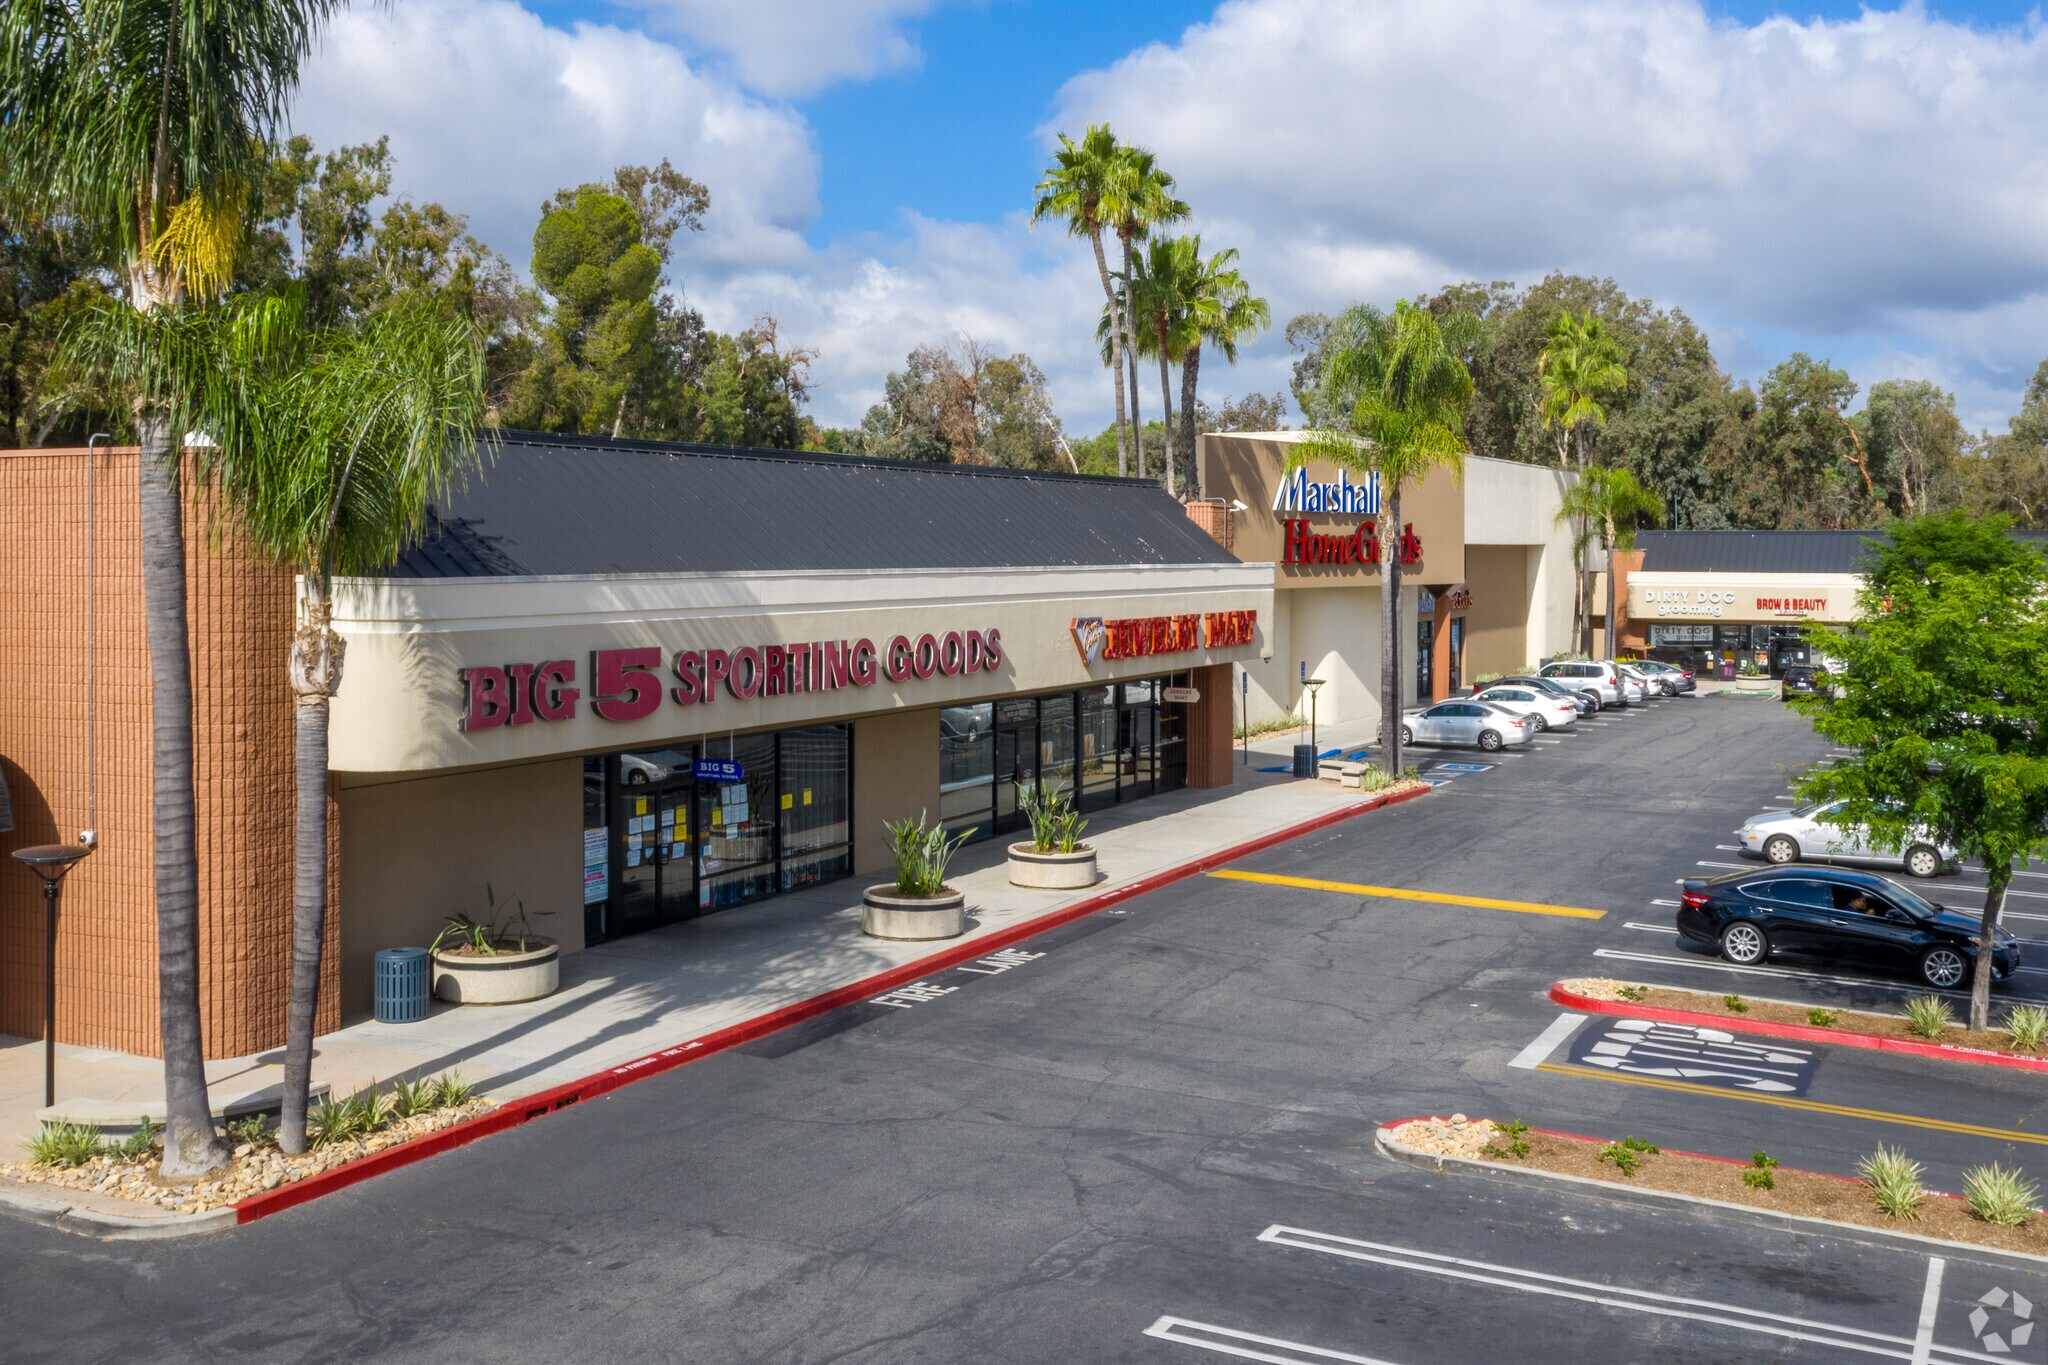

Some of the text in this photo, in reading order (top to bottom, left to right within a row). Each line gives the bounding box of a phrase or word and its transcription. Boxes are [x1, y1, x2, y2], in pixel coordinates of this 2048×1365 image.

[1272, 466, 1384, 514] Marshall
[1281, 518, 1423, 564] HomeGds
[1645, 591, 1735, 605] DIRTY DOG
[1657, 605, 1722, 618] grooming
[1756, 598, 1827, 611] BROW & BEAUTY
[1102, 613, 1201, 660] JEWELRY
[1203, 609, 1257, 649] MART
[1654, 627, 1711, 635] DIRTY DOG
[457, 660, 581, 732] BIG
[589, 646, 663, 723] 5
[670, 638, 877, 706] SPORTING
[882, 627, 1003, 684] GOODS
[700, 762, 736, 774] BIG 5
[868, 947, 1048, 1009] FIRE LANE
[1581, 1018, 1813, 1093] STOP
